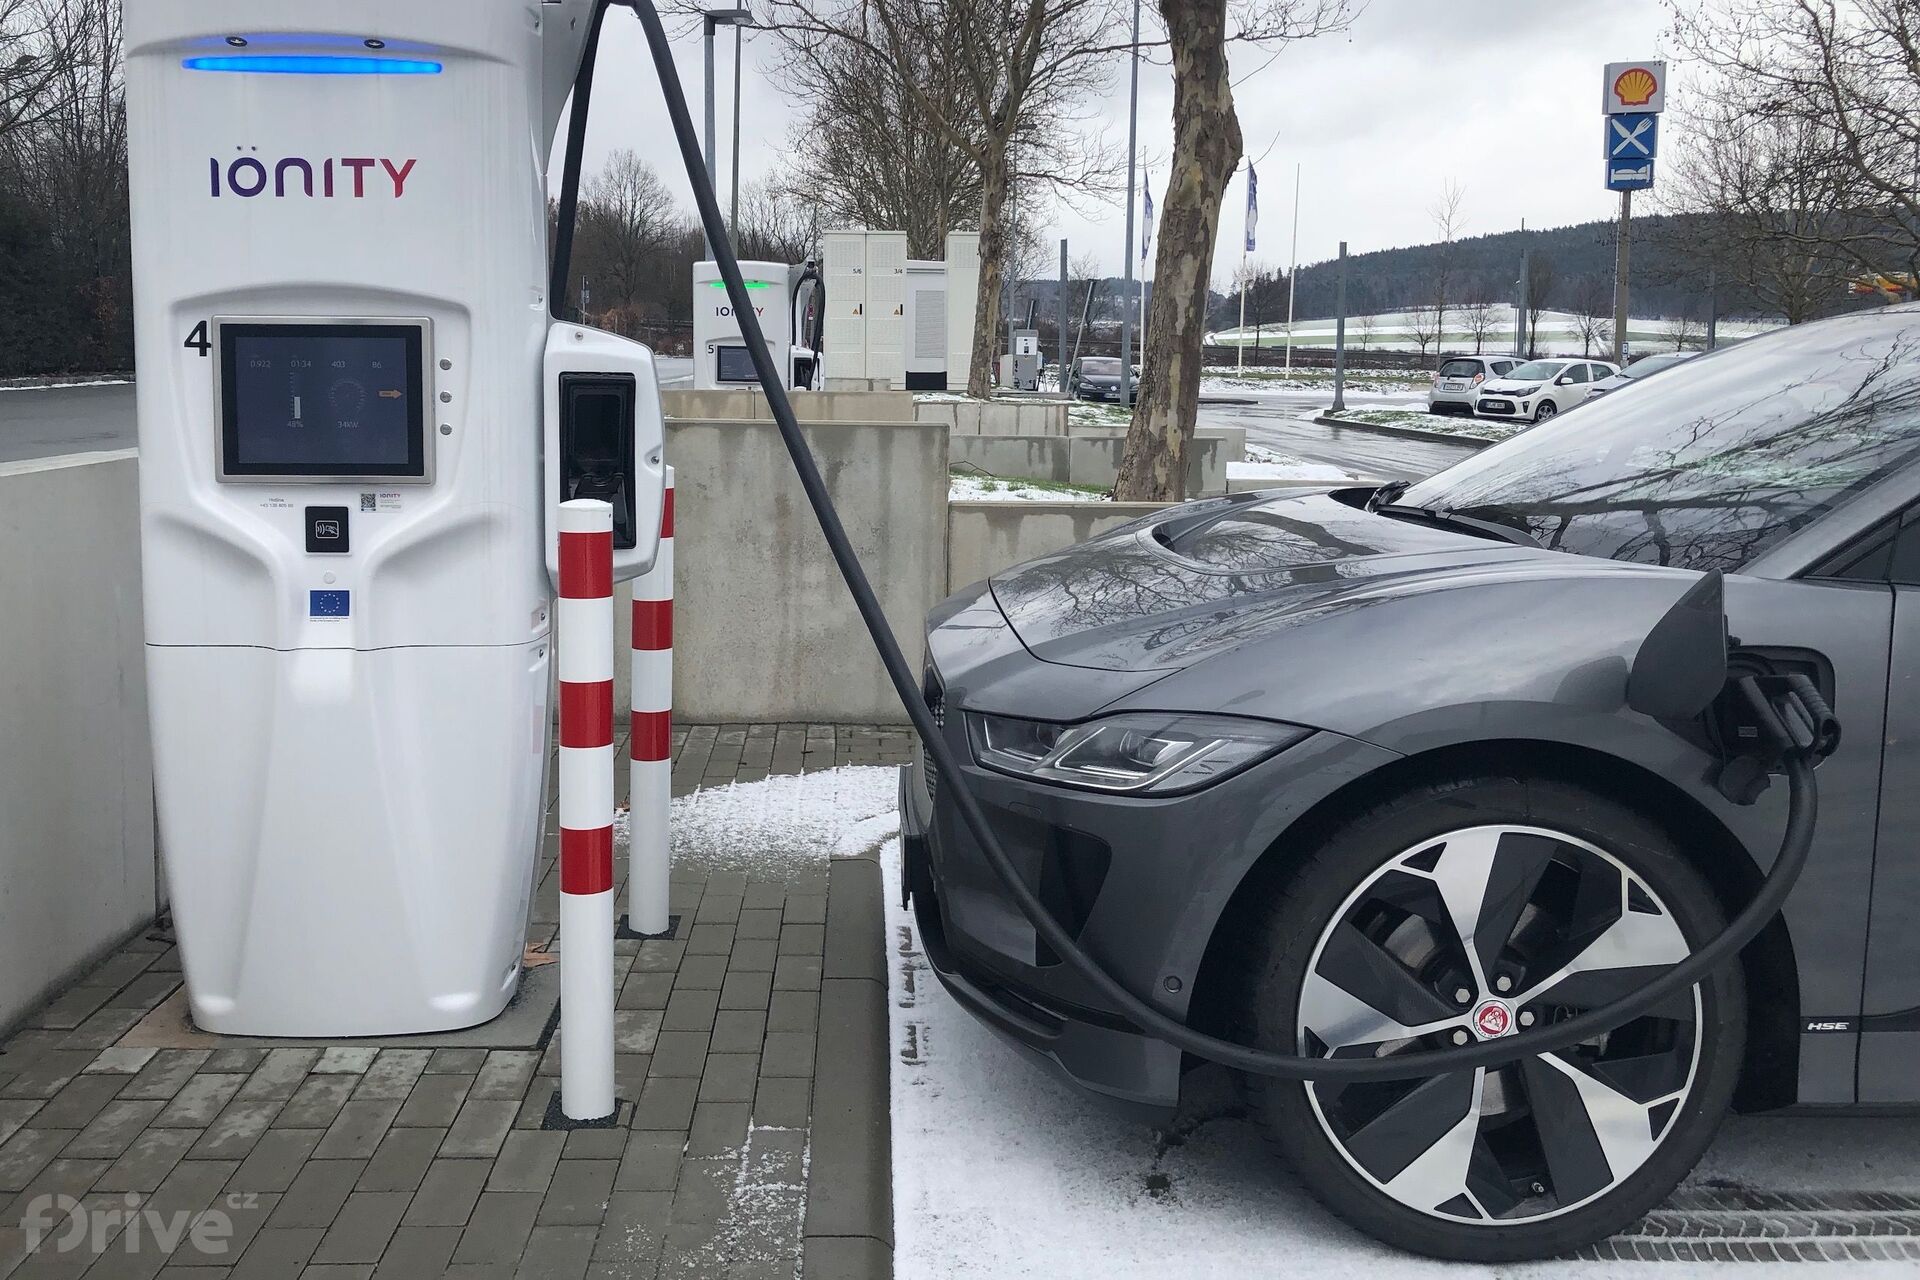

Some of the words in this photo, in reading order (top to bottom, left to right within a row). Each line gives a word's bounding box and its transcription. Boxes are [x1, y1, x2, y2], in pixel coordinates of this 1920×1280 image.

[183, 320, 212, 357] 4
[707, 344, 715, 354] 5
[331, 360, 346, 368] 403
[1807, 1022, 1850, 1031] HSE
